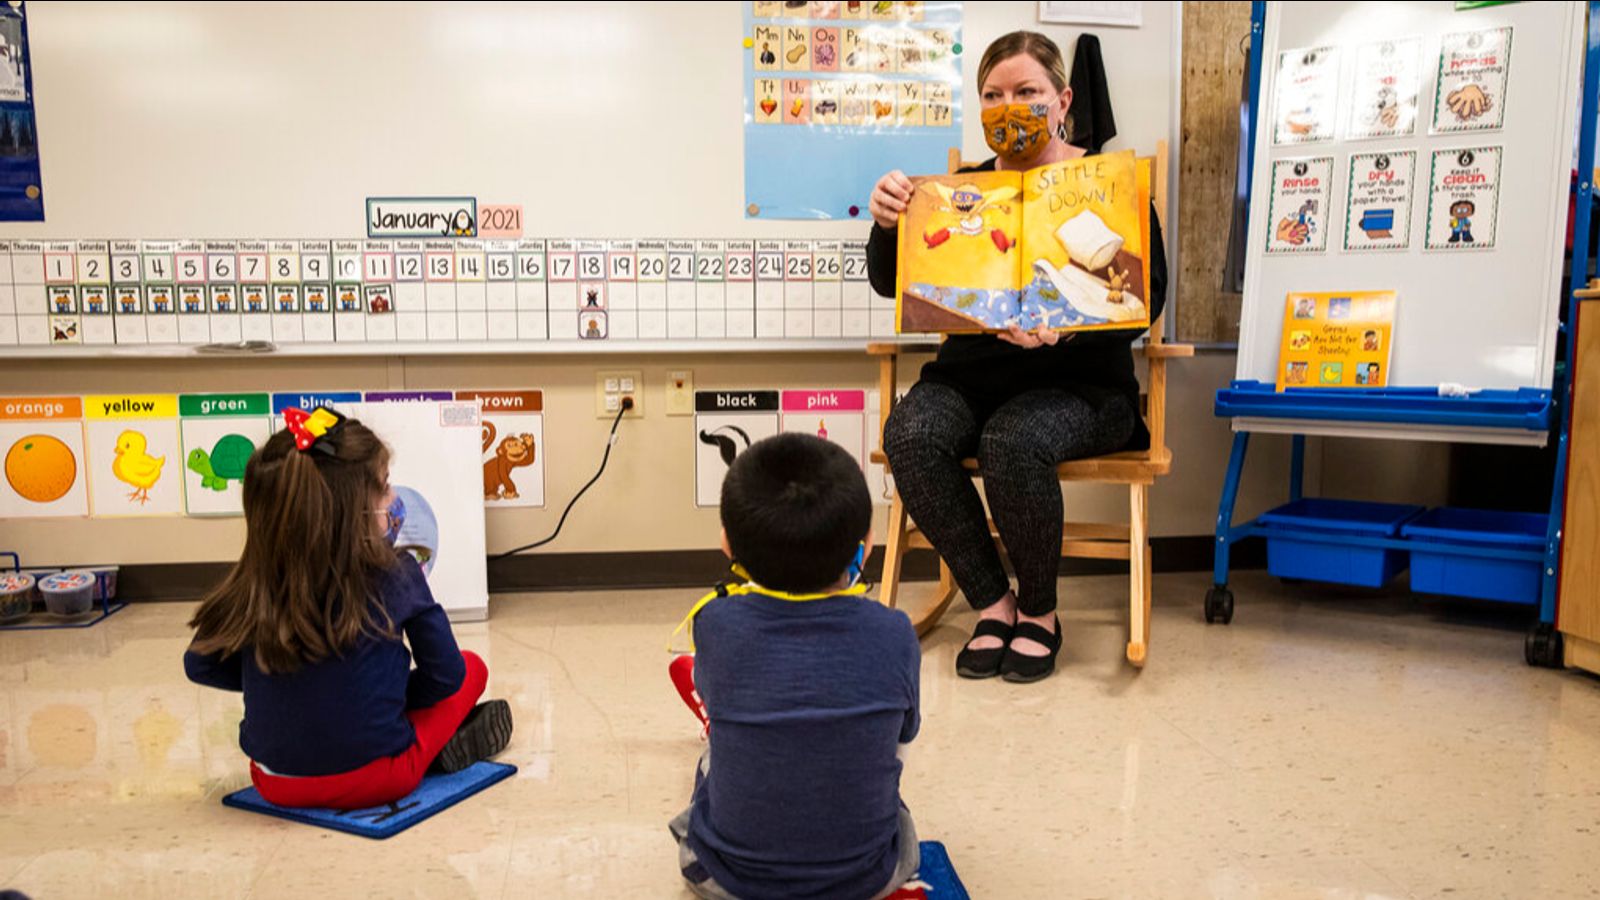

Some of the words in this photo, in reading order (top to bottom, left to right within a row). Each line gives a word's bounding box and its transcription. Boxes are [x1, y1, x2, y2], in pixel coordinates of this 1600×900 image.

[756, 27, 778, 40] Mm
[788, 29, 804, 40] Nn
[815, 28, 835, 41] Oo
[847, 29, 860, 45] Pp
[761, 80, 774, 93] Tt
[789, 82, 804, 94] Uu
[904, 83, 918, 99] Yy
[1037, 161, 1105, 190] SETTLE
[1049, 182, 1116, 213] DOWN!
[372, 207, 453, 237] January
[481, 208, 520, 231] 2021
[57, 260, 62, 277] 1
[86, 260, 99, 277] 2
[120, 260, 132, 277] 3
[152, 259, 164, 277] 4
[184, 260, 196, 277] 5
[215, 259, 229, 277] 6
[246, 258, 258, 276] 7
[278, 258, 290, 277] 8
[308, 259, 320, 277] 9
[339, 259, 355, 276] 10
[372, 258, 386, 275] 11
[401, 258, 417, 276] 12
[431, 258, 448, 275] 13
[461, 258, 478, 276] 14
[492, 259, 509, 276] 15
[520, 257, 539, 275] 16
[553, 258, 570, 276] 17
[583, 257, 600, 275] 18
[614, 257, 630, 275] 19
[640, 258, 664, 275] 20
[671, 257, 691, 274] 21
[700, 258, 722, 275] 22
[728, 257, 751, 275] 23
[759, 257, 781, 275] 24
[788, 257, 811, 275] 25
[817, 257, 840, 274] 26
[845, 257, 867, 275] 27
[103, 400, 154, 415] yellow
[201, 398, 247, 412] green
[717, 395, 757, 407] black
[807, 395, 839, 407] pink
[5, 404, 64, 416] orange
